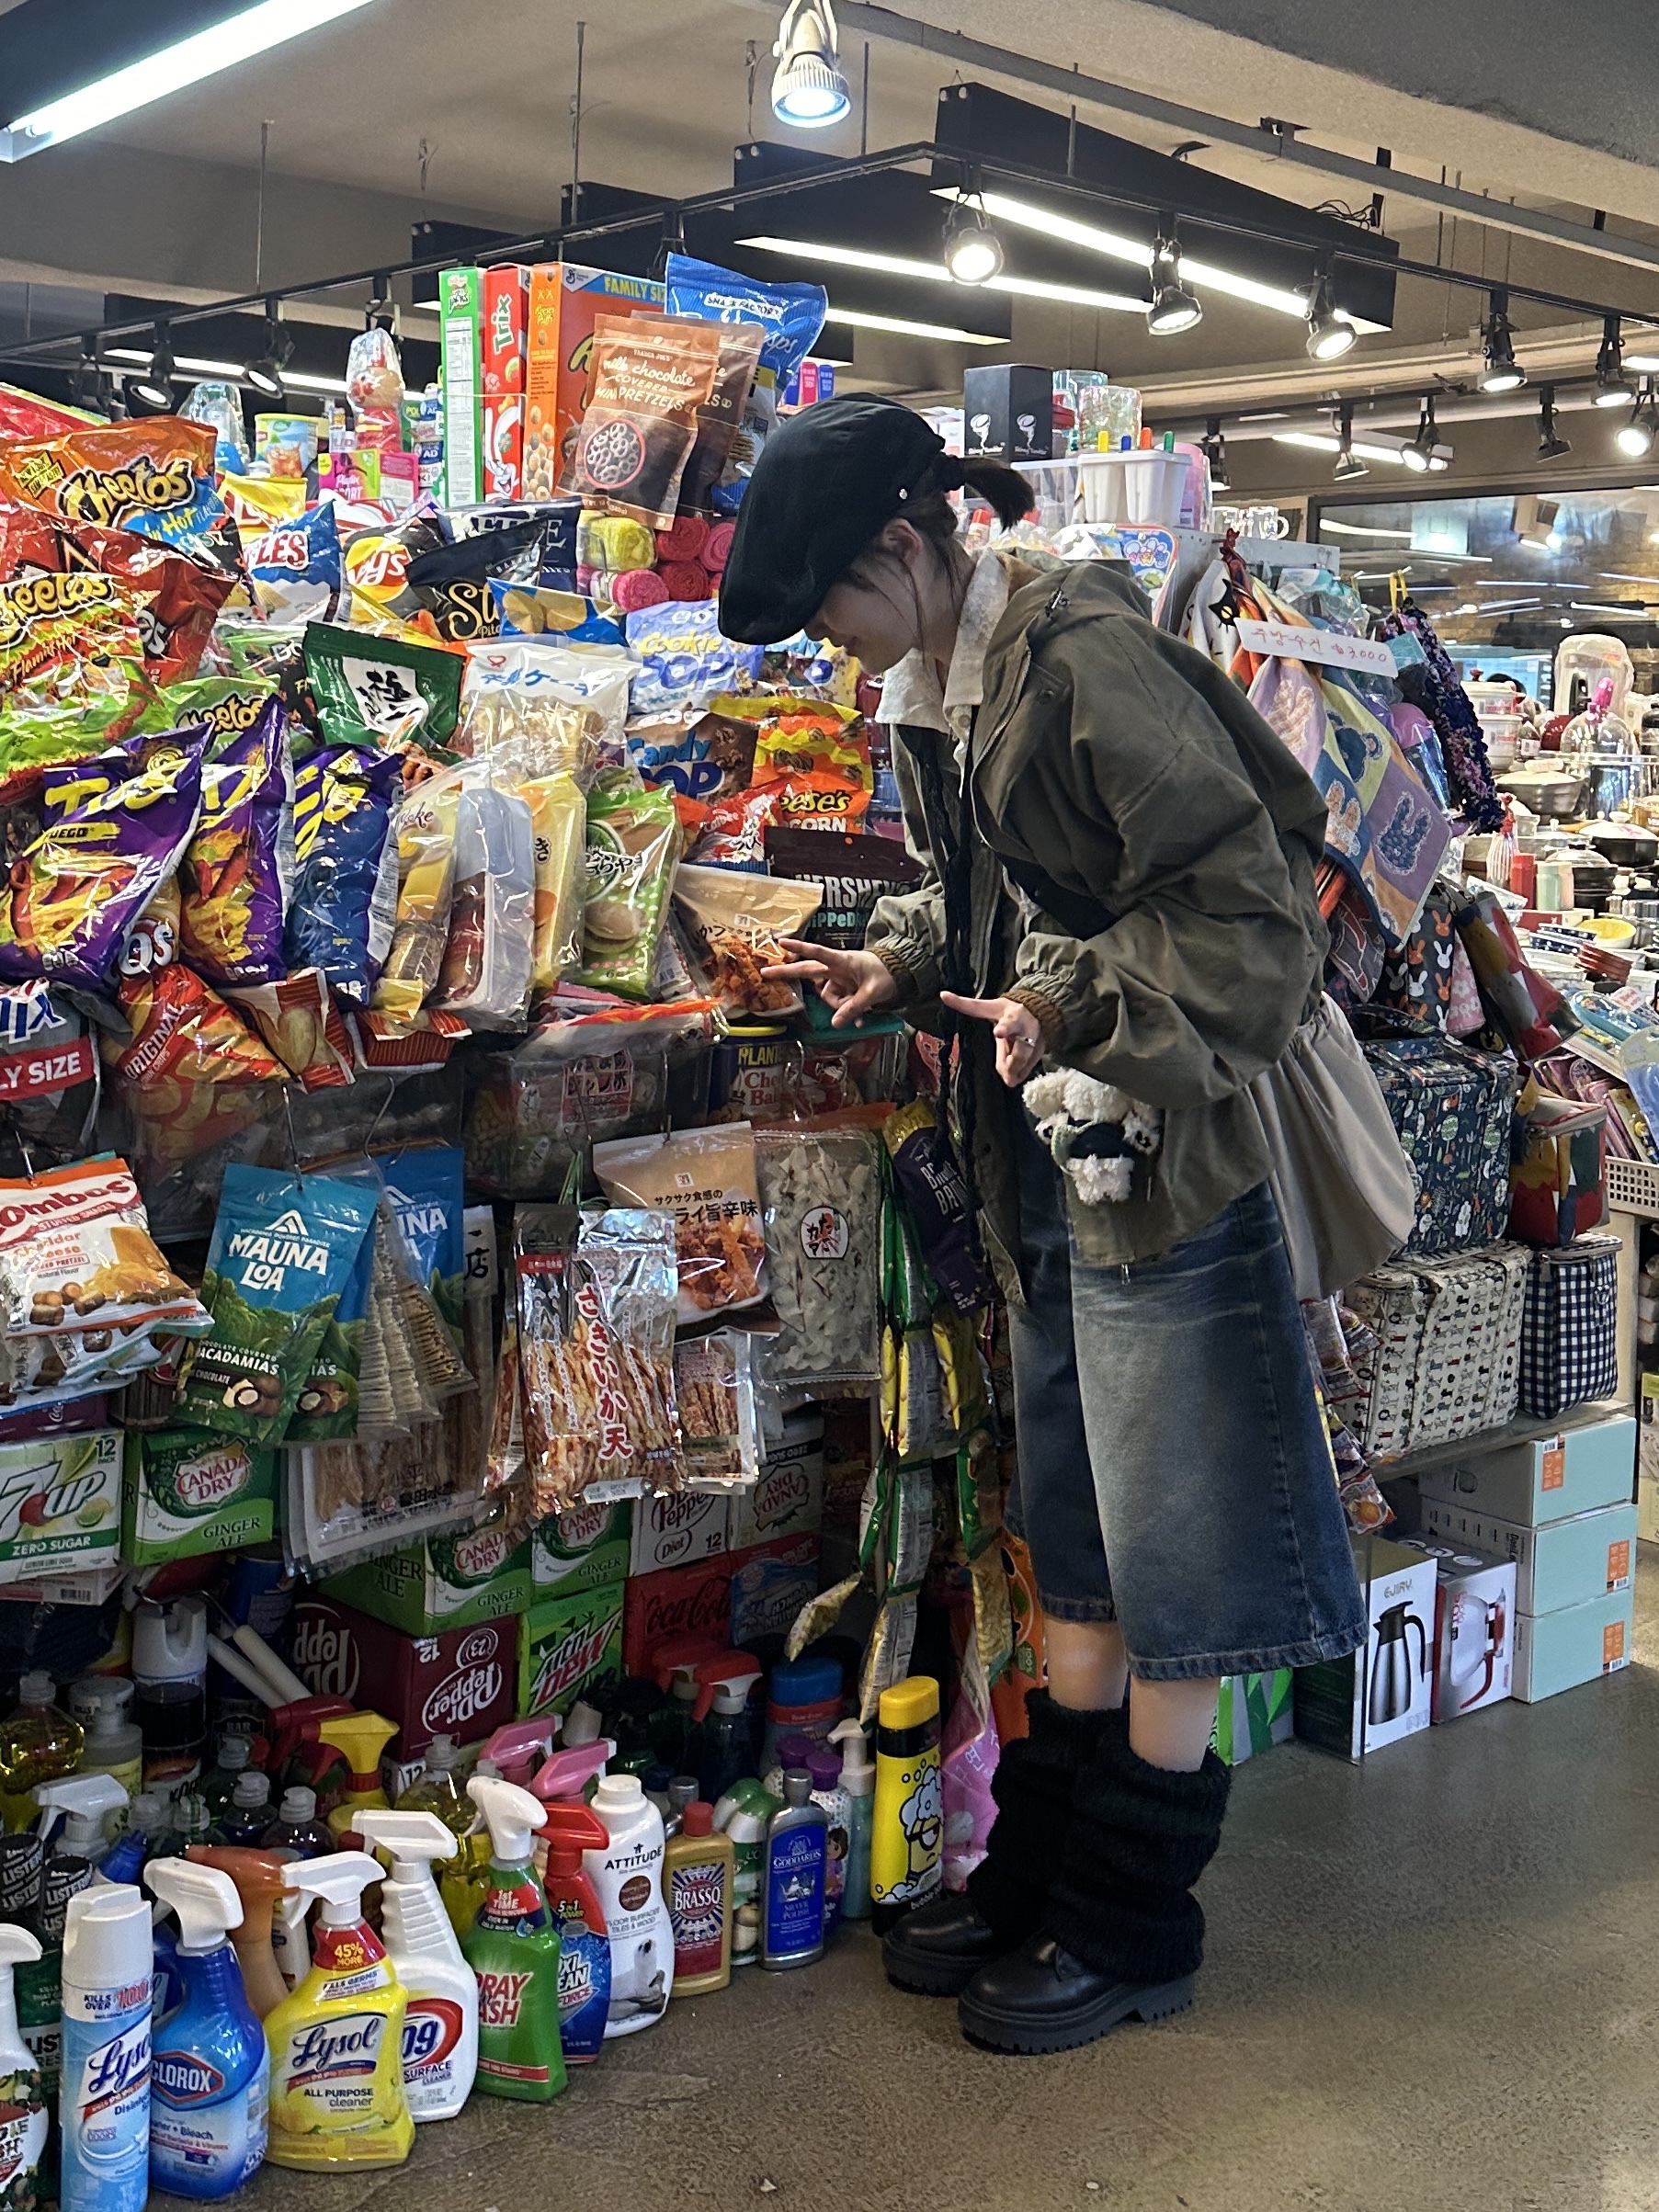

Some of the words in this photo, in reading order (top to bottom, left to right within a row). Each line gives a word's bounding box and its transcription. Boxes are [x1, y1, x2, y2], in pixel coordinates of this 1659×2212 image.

[604, 275, 644, 300] FAMILY
[650, 283, 665, 302] SIZ
[493, 293, 516, 355] Trix
[603, 356, 629, 369] milk
[632, 358, 696, 387] chocolate
[614, 373, 669, 393] COVERED
[618, 387, 686, 413] PRETZELS
[61, 455, 194, 528] Cheetos
[640, 630, 722, 656] Cookie
[628, 727, 712, 767] Candy
[124, 1002, 187, 1081] ORIGINAL
[737, 1043, 781, 1066] PLANT
[28, 1051, 82, 1085] SIZE
[744, 1072, 778, 1090] Che
[749, 1089, 778, 1106] Bal
[0, 1178, 131, 1234] ombos
[653, 1189, 723, 1206] サクサク食感の
[227, 1233, 330, 1276] MAUNA
[239, 1261, 286, 1292] LOA
[238, 1346, 278, 1362] COVERED
[96, 1438, 117, 1458] 12
[176, 1452, 252, 1496] CANADA
[765, 1470, 793, 1498] DRY
[198, 1476, 236, 1503] DRY
[752, 1474, 810, 1517] CANADA
[202, 1515, 261, 1540] GINGER
[575, 1516, 603, 1541] DRY
[12, 1541, 48, 1557] ZERO
[50, 1536, 91, 1552] SUGAR
[214, 1532, 247, 1550] ALE
[454, 1530, 505, 1571] CANAD
[661, 1537, 685, 1560] Diet
[705, 1532, 722, 1549] 12
[472, 1549, 502, 1572] DRY
[577, 1556, 622, 1577] GINGER
[375, 1573, 405, 1599] ALE
[477, 1585, 525, 1608] GINGER
[489, 1603, 513, 1617] ALE
[293, 1617, 351, 1696] Pepp
[418, 1643, 441, 1663] 12
[468, 1637, 486, 1658] 23
[531, 1611, 621, 1713] DEW
[427, 1662, 495, 1722] Pepper
[446, 1696, 476, 1725] Dr
[604, 1843, 663, 1871] ATTITUDE
[493, 1897, 520, 1910] TIME
[498, 1889, 513, 1901] 1st
[675, 1886, 722, 1911] BRASSO
[334, 1943, 365, 1959] 45%
[336, 1957, 363, 1967] MORE
[347, 1969, 379, 1986] GERMS
[559, 1966, 589, 1991] EAN
[84, 1993, 112, 2003] KILLS
[85, 2001, 112, 2011] OVER
[479, 2001, 521, 2026] ASH
[291, 2017, 381, 2069] Lysol
[403, 2020, 439, 2057] 09
[88, 2031, 152, 2093] Lyso
[403, 2060, 452, 2080] SURFACE
[151, 2059, 212, 2093] CLOROX
[303, 2088, 324, 2098] ALL
[324, 2087, 375, 2098] PURPOSE
[329, 2096, 374, 2108] cleaner
[180, 2126, 214, 2141] Bleach
